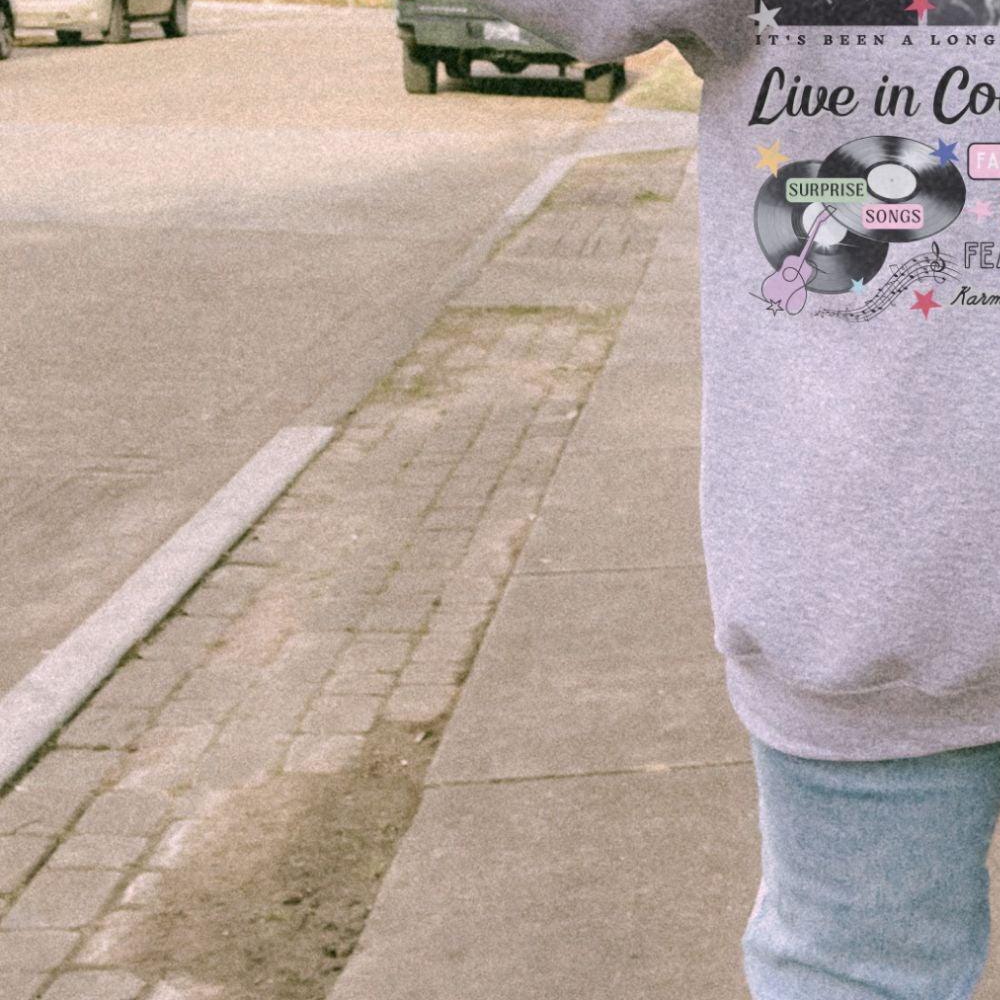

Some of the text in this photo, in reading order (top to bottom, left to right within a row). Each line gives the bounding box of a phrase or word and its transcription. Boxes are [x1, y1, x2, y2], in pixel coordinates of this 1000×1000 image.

[755, 34, 807, 46] IT'S
[823, 34, 885, 46] BEEN
[901, 34, 913, 46] A
[930, 34, 996, 46] LONG
[748, 66, 859, 126] Live
[873, 74, 921, 117] in
[788, 182, 865, 197] SURPRISE
[865, 209, 921, 224] SONGS
